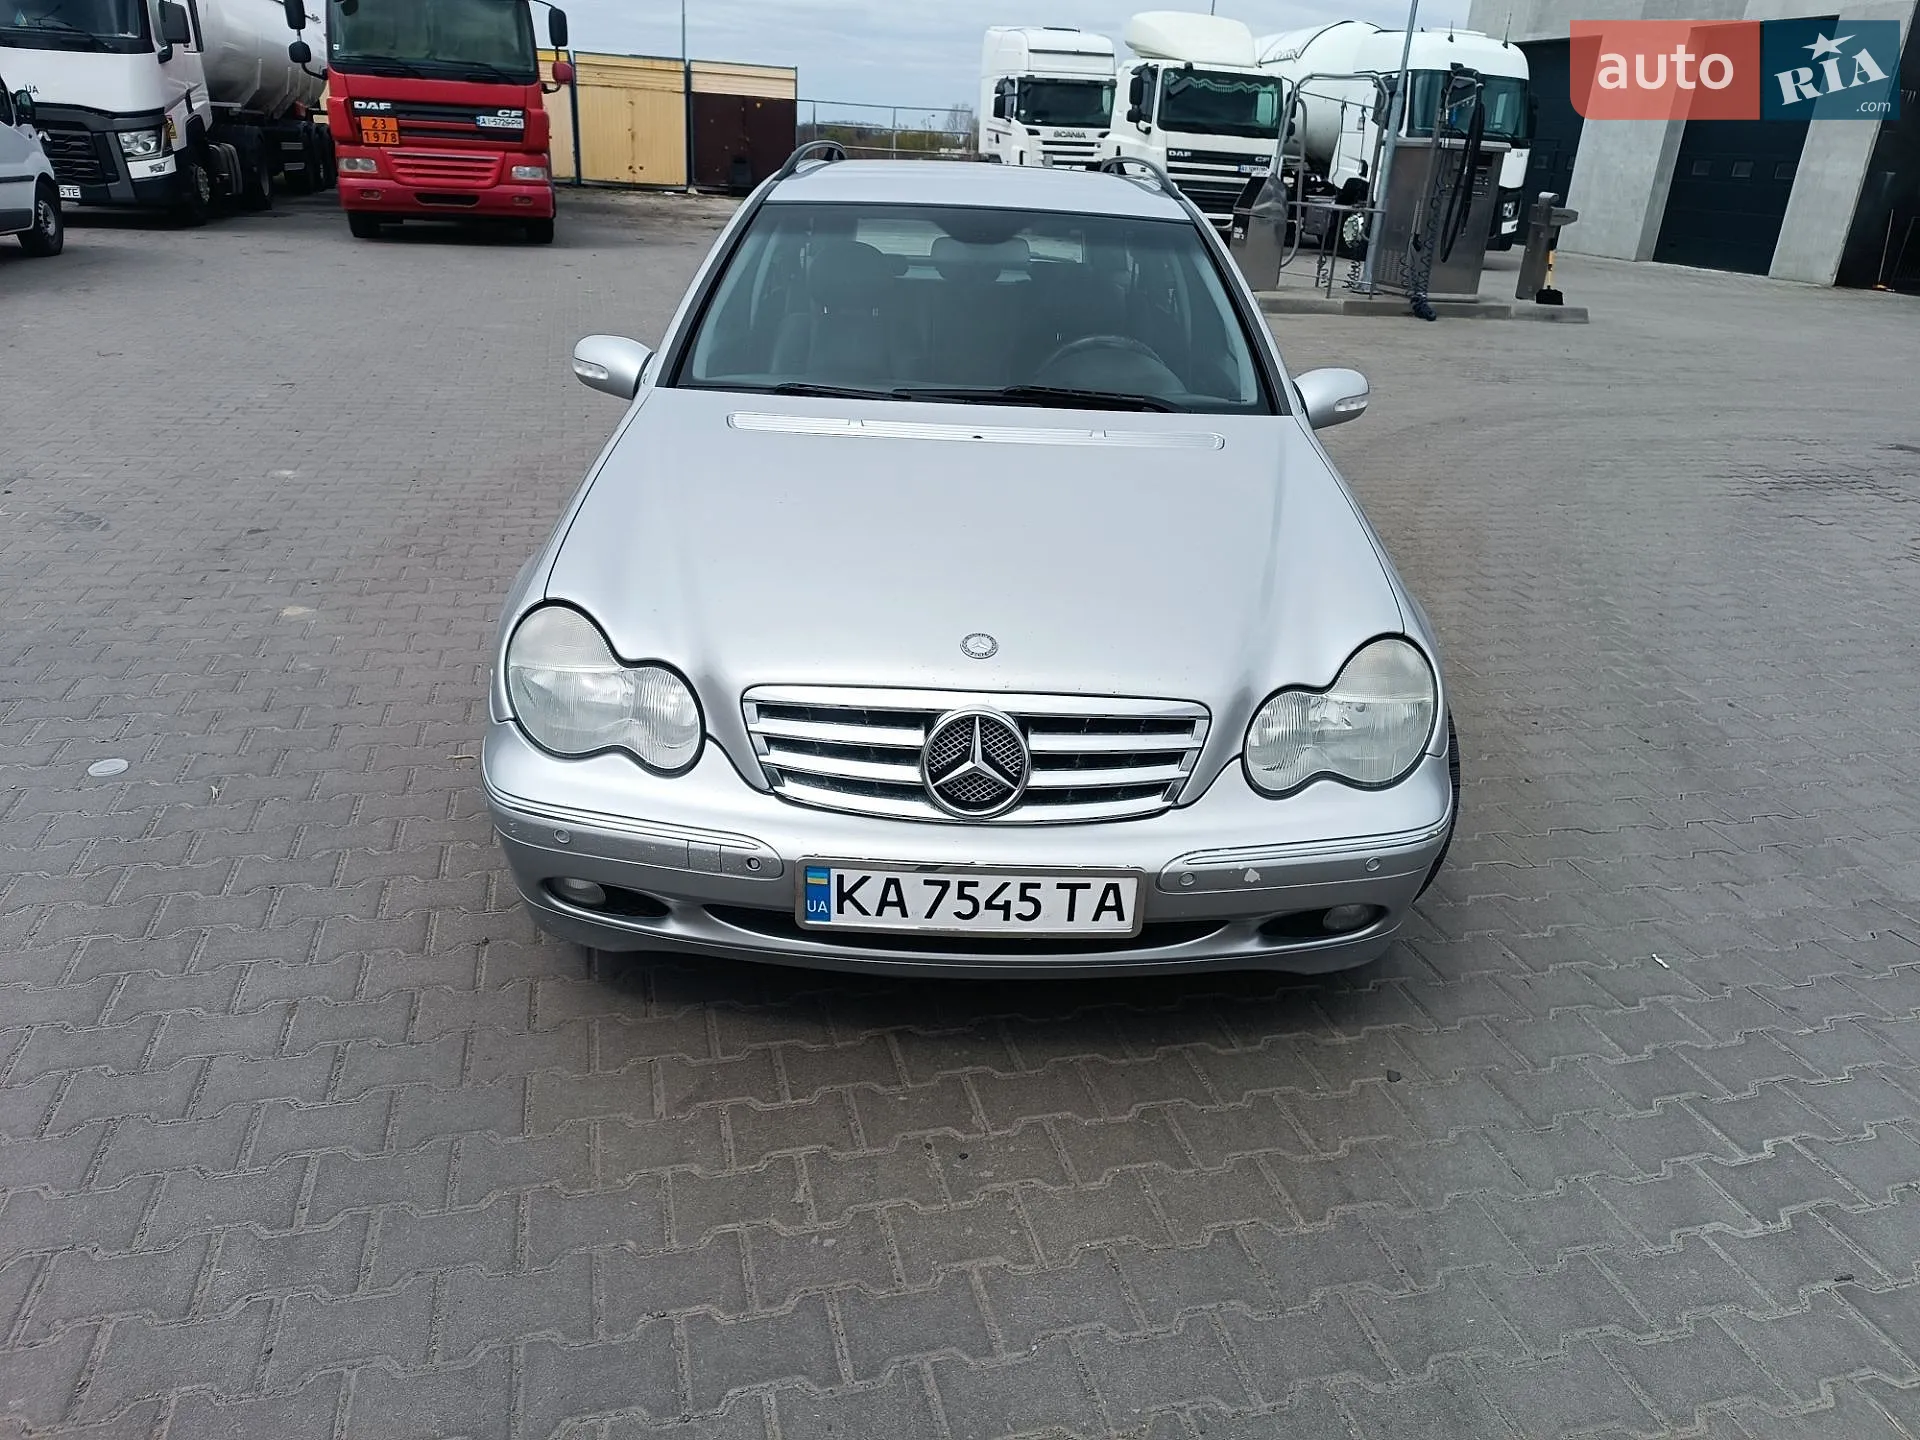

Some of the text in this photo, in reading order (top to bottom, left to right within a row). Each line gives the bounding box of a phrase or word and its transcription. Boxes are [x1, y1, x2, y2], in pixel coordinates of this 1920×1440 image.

[353, 101, 392, 110] DAF
[497, 109, 523, 118] CF
[372, 118, 387, 129] 23
[364, 131, 397, 143] 1978
[1053, 130, 1087, 138] SCANIA
[836, 873, 1126, 922] KA 7545 TA
[807, 899, 829, 913] UA
